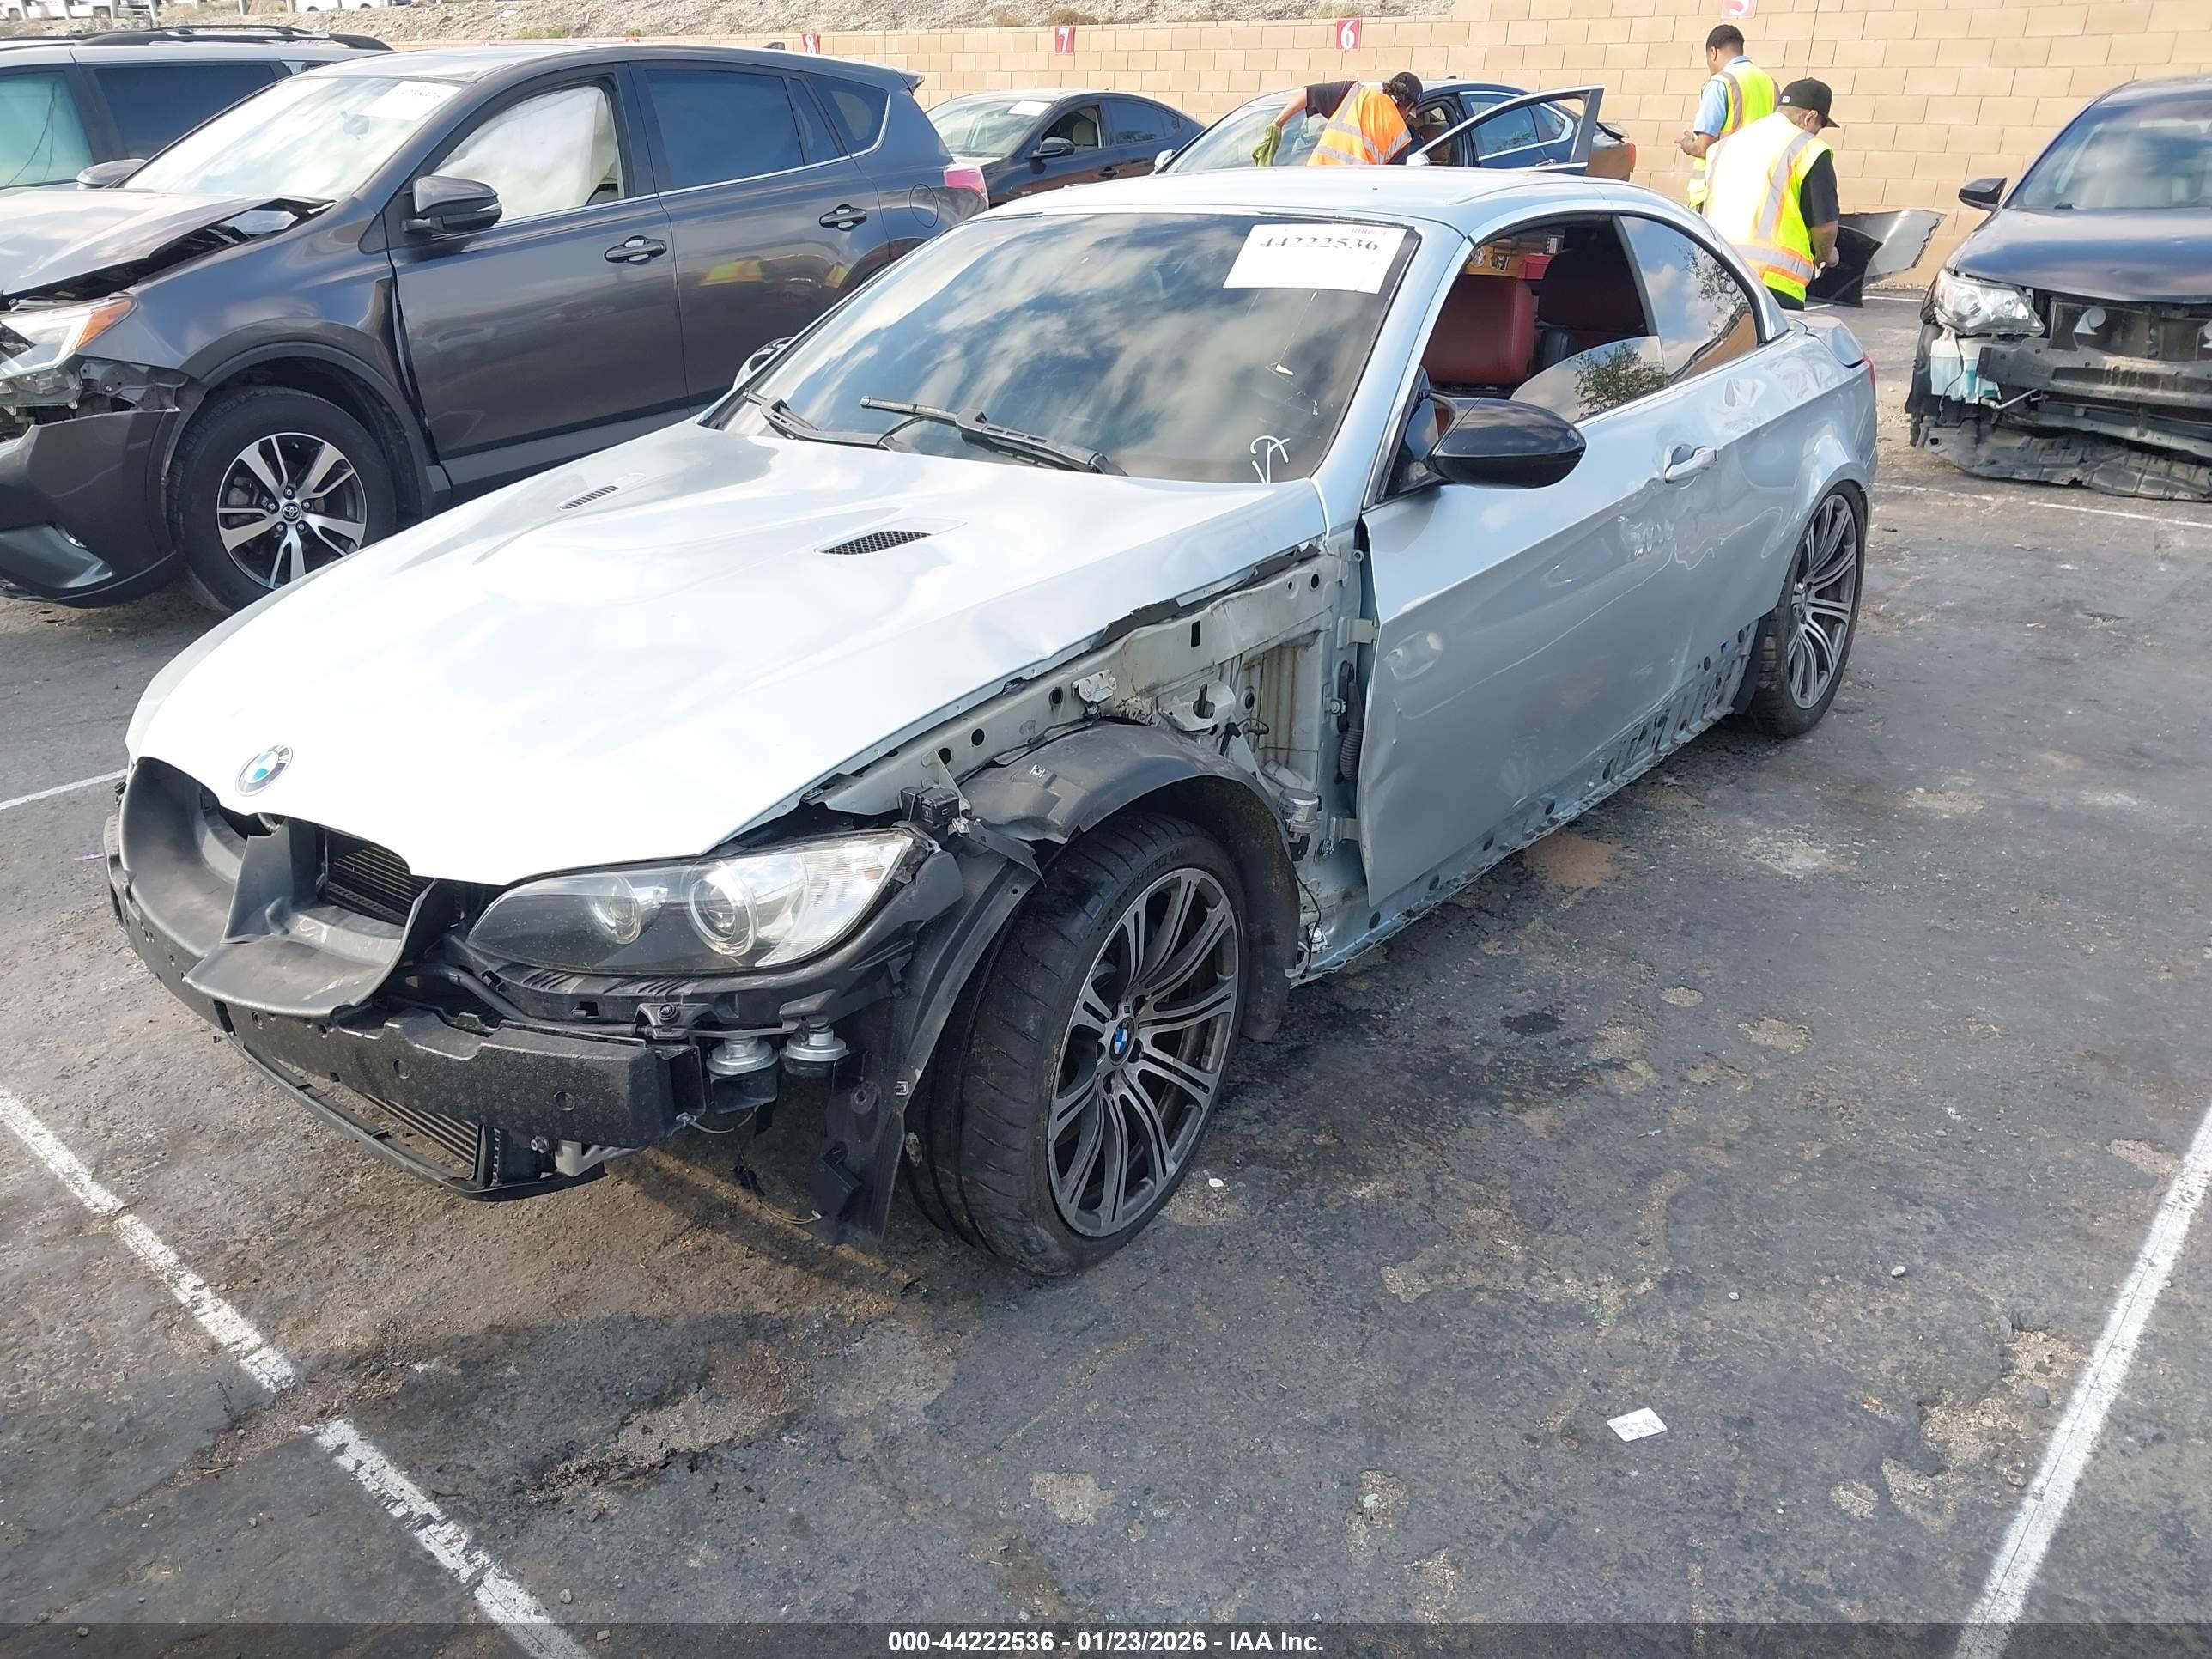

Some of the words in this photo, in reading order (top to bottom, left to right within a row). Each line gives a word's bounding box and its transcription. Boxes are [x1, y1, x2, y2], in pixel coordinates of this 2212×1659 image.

[1058, 27, 1071, 54] 7
[1340, 20, 1356, 52] 6
[1260, 237, 1379, 251] 44222536
